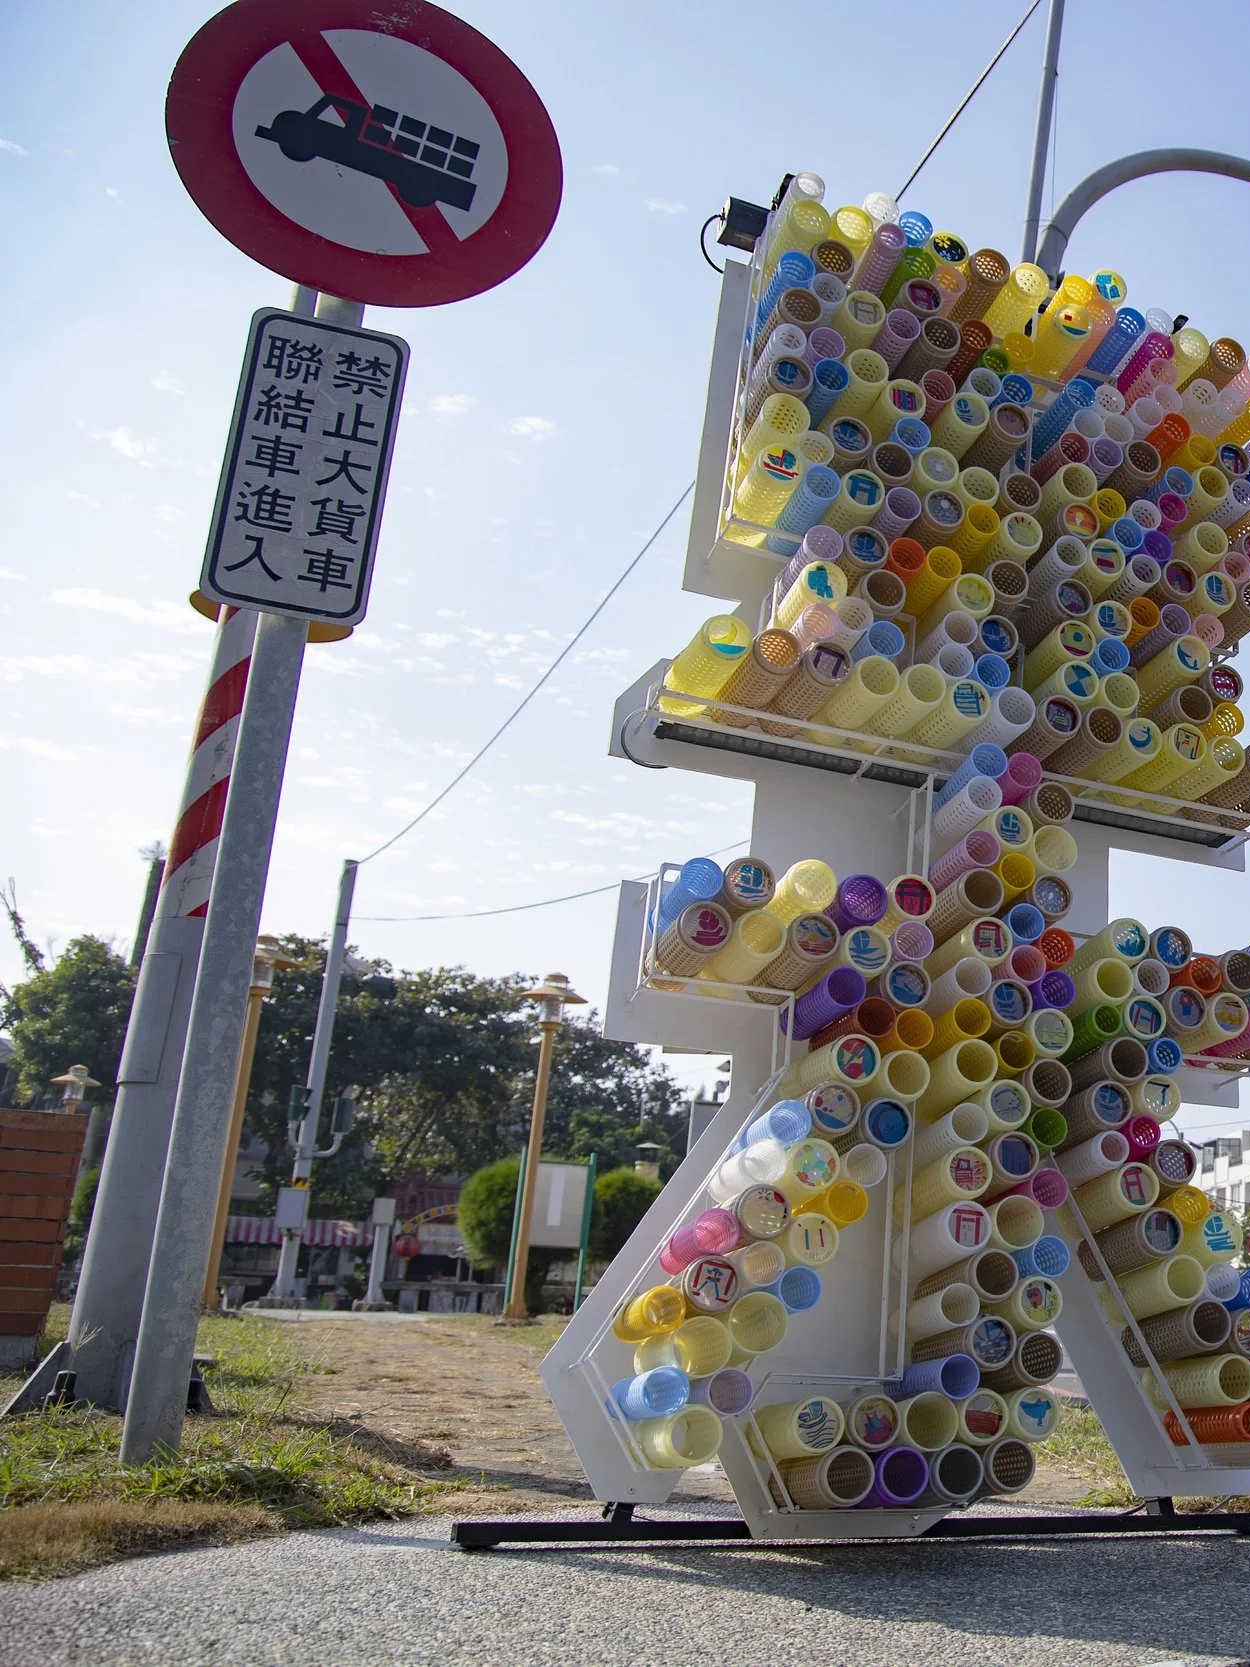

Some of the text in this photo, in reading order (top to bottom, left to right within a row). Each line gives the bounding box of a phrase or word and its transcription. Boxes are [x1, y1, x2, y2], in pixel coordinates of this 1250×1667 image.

[223, 334, 323, 582] 聯結車進入
[298, 350, 391, 593] 禁止大貨車
